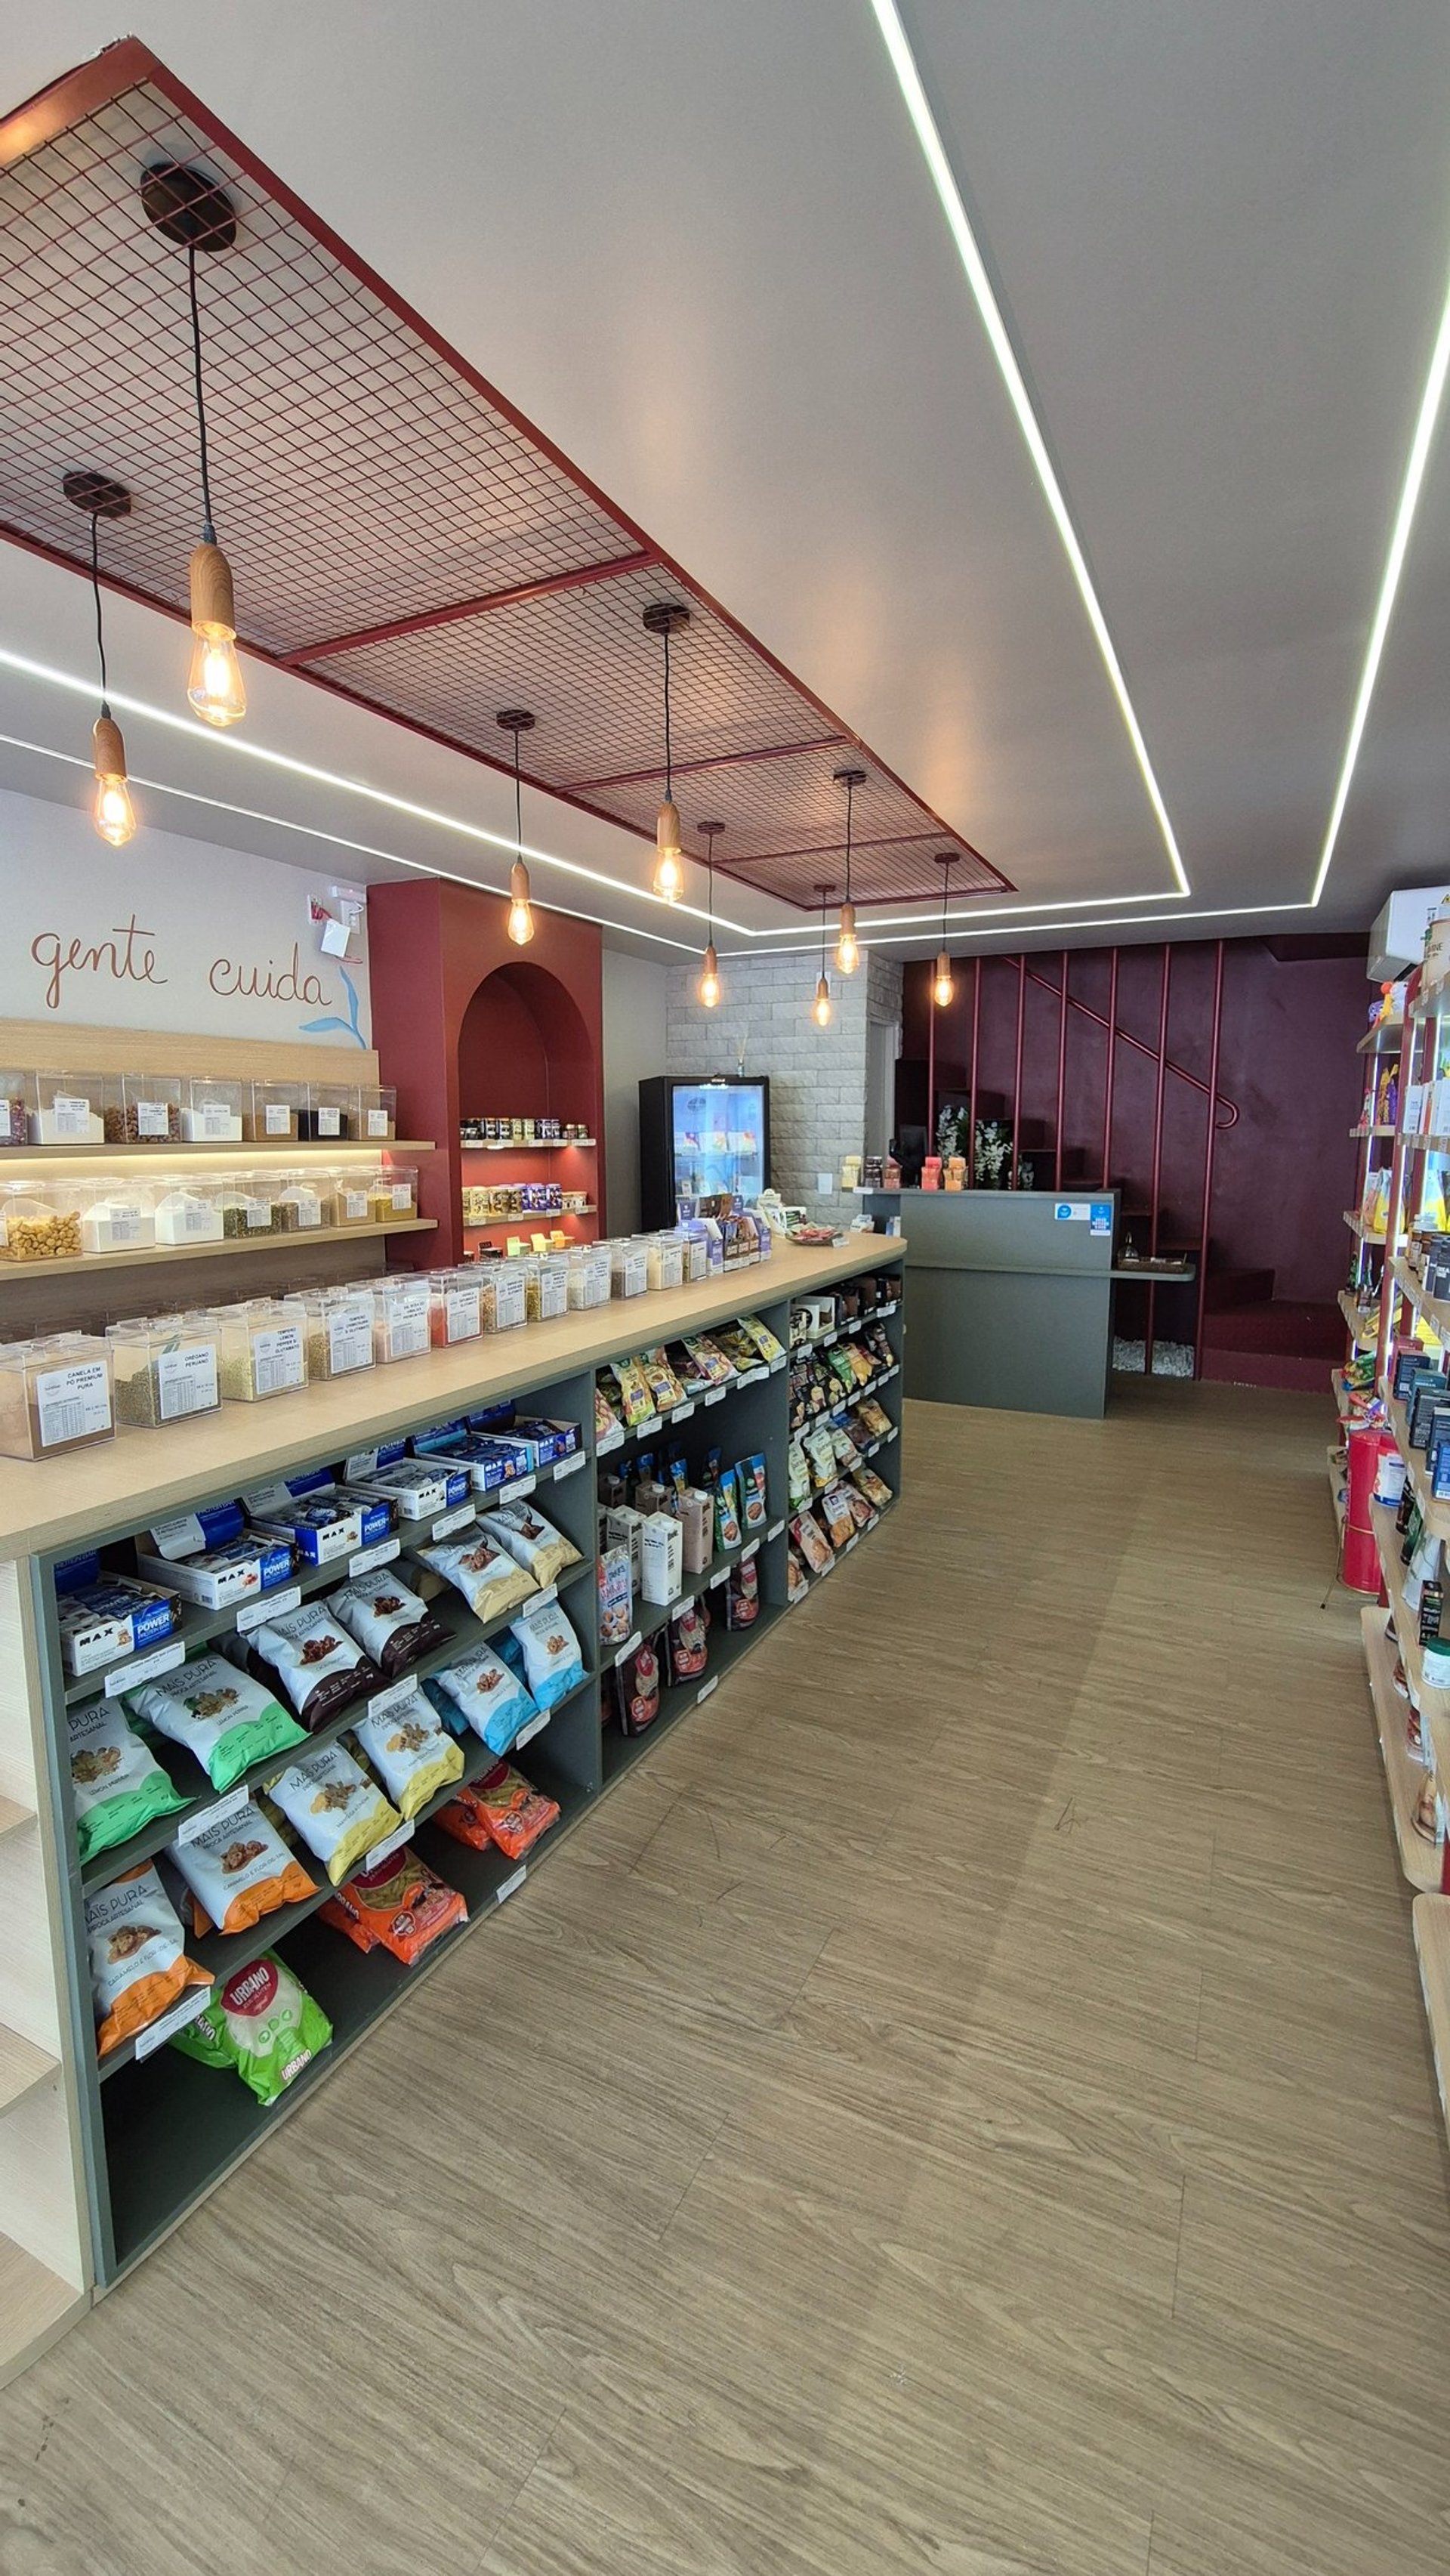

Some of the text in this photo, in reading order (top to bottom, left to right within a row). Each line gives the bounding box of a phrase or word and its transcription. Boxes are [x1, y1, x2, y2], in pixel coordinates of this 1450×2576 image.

[31, 913, 332, 1008] gente cuida
[67, 1367, 91, 1379] CANELA
[76, 1373, 103, 1384] PREMIUM
[77, 1382, 94, 1391] PURA
[485, 1460, 503, 1472] MAX
[418, 1487, 437, 1499] MAX
[322, 1527, 345, 1540] MAX
[364, 1518, 387, 1532] POWER
[218, 1568, 245, 1584] MAX
[264, 1558, 290, 1577] POWER
[137, 1614, 171, 1634] POWER
[297, 1605, 327, 1627] PURA
[79, 1627, 113, 1647] MAX
[155, 1678, 187, 1697] MAIS
[187, 1658, 218, 1681] PURA
[67, 1707, 111, 1731] PURA
[69, 1721, 107, 1743] ARTESANAL
[289, 1751, 338, 1791] MAS PURA
[191, 1806, 255, 1848] MAIS PURA
[224, 1820, 253, 1839] ARTESANAL
[110, 1885, 149, 1910] PURA
[335, 1891, 360, 1920] RBANO
[111, 1900, 143, 1923] ARTESANAL
[108, 1961, 140, 1988] CARAMELO
[230, 1966, 270, 2006] URBANO
[281, 2048, 313, 2080] URBANO
